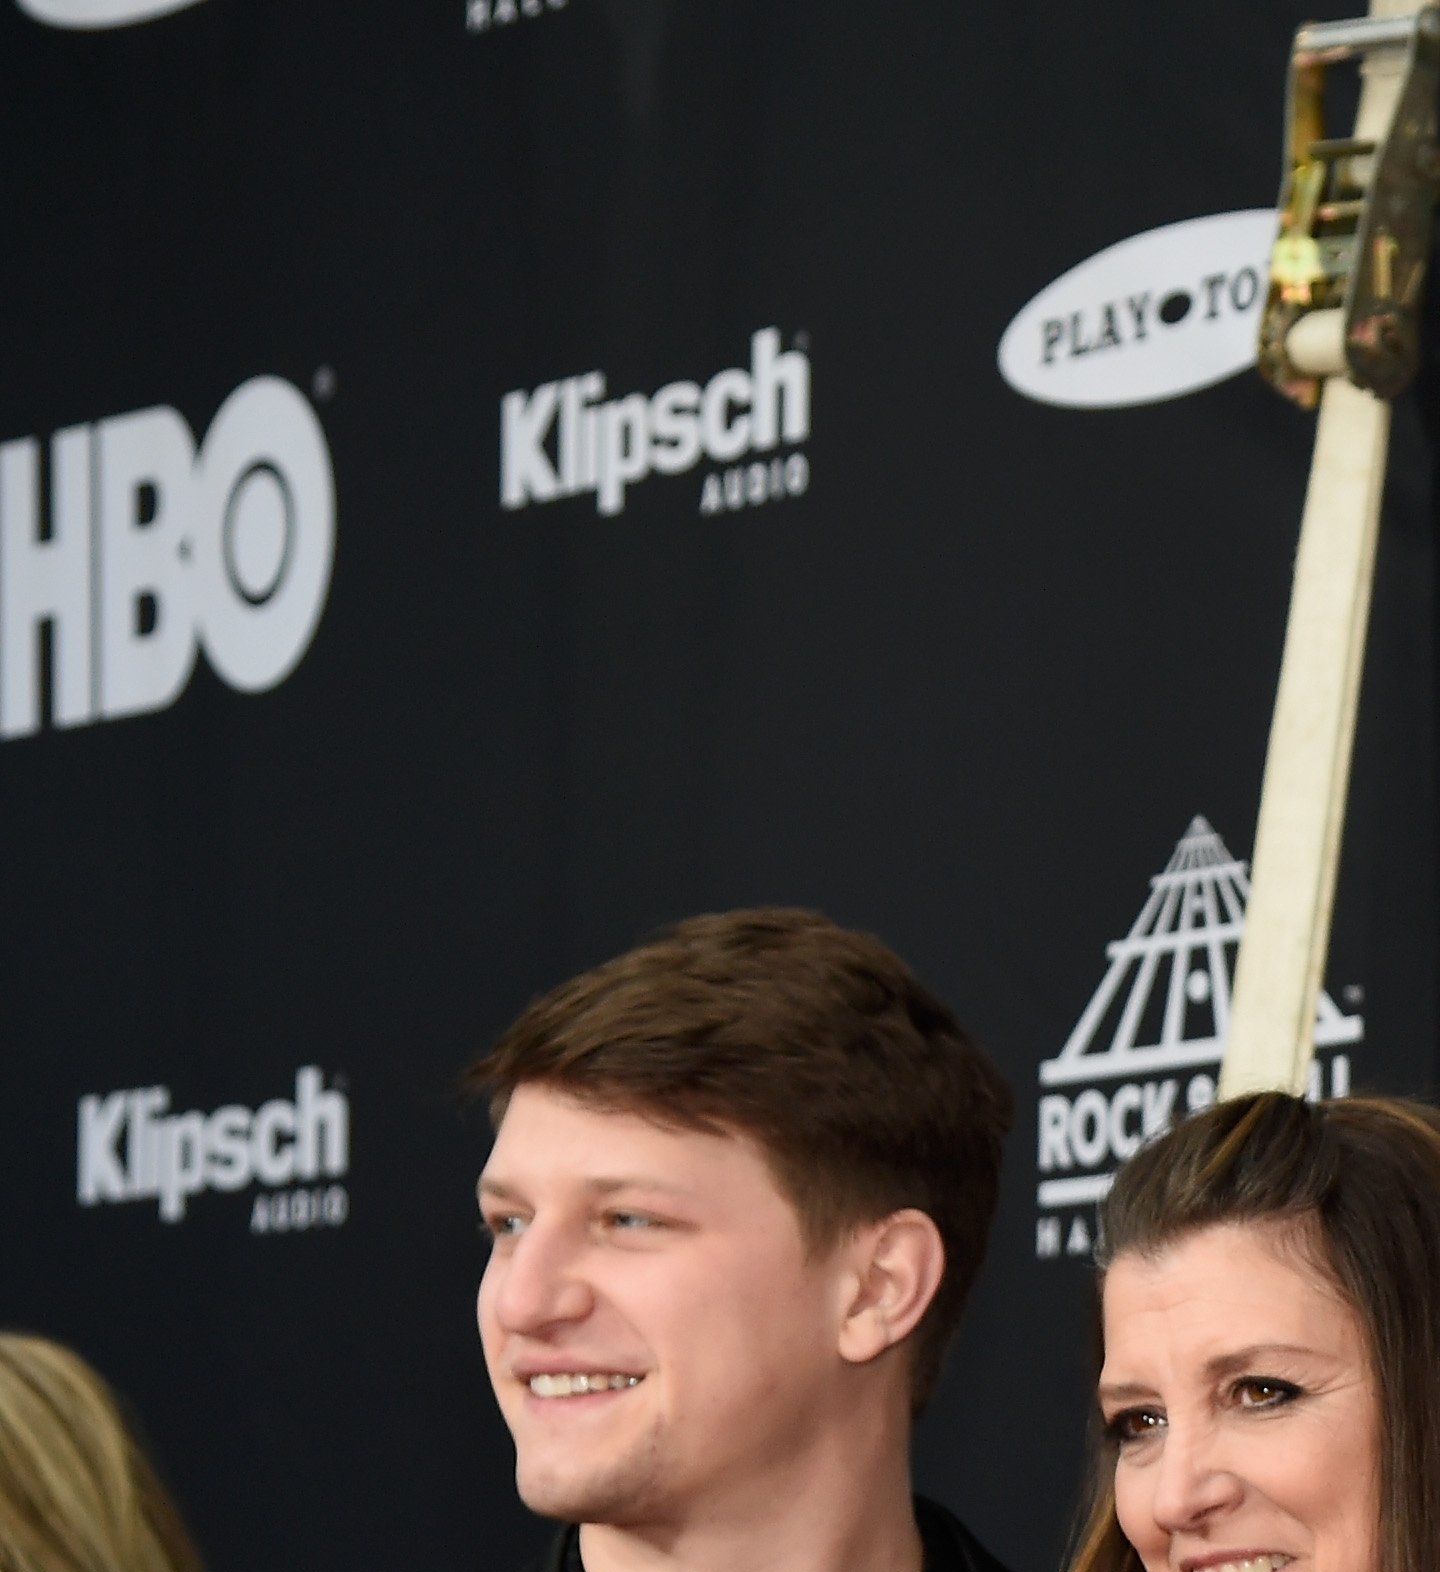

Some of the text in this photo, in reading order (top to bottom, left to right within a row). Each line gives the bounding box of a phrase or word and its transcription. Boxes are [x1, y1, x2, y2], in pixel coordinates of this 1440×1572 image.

[1041, 291, 1151, 366] PLAY
[501, 325, 811, 517] Klipsch
[700, 453, 810, 517] AUDIO
[0, 374, 337, 740] HBO
[77, 1064, 349, 1226] Klipsch
[1039, 1079, 1178, 1172] ROCK
